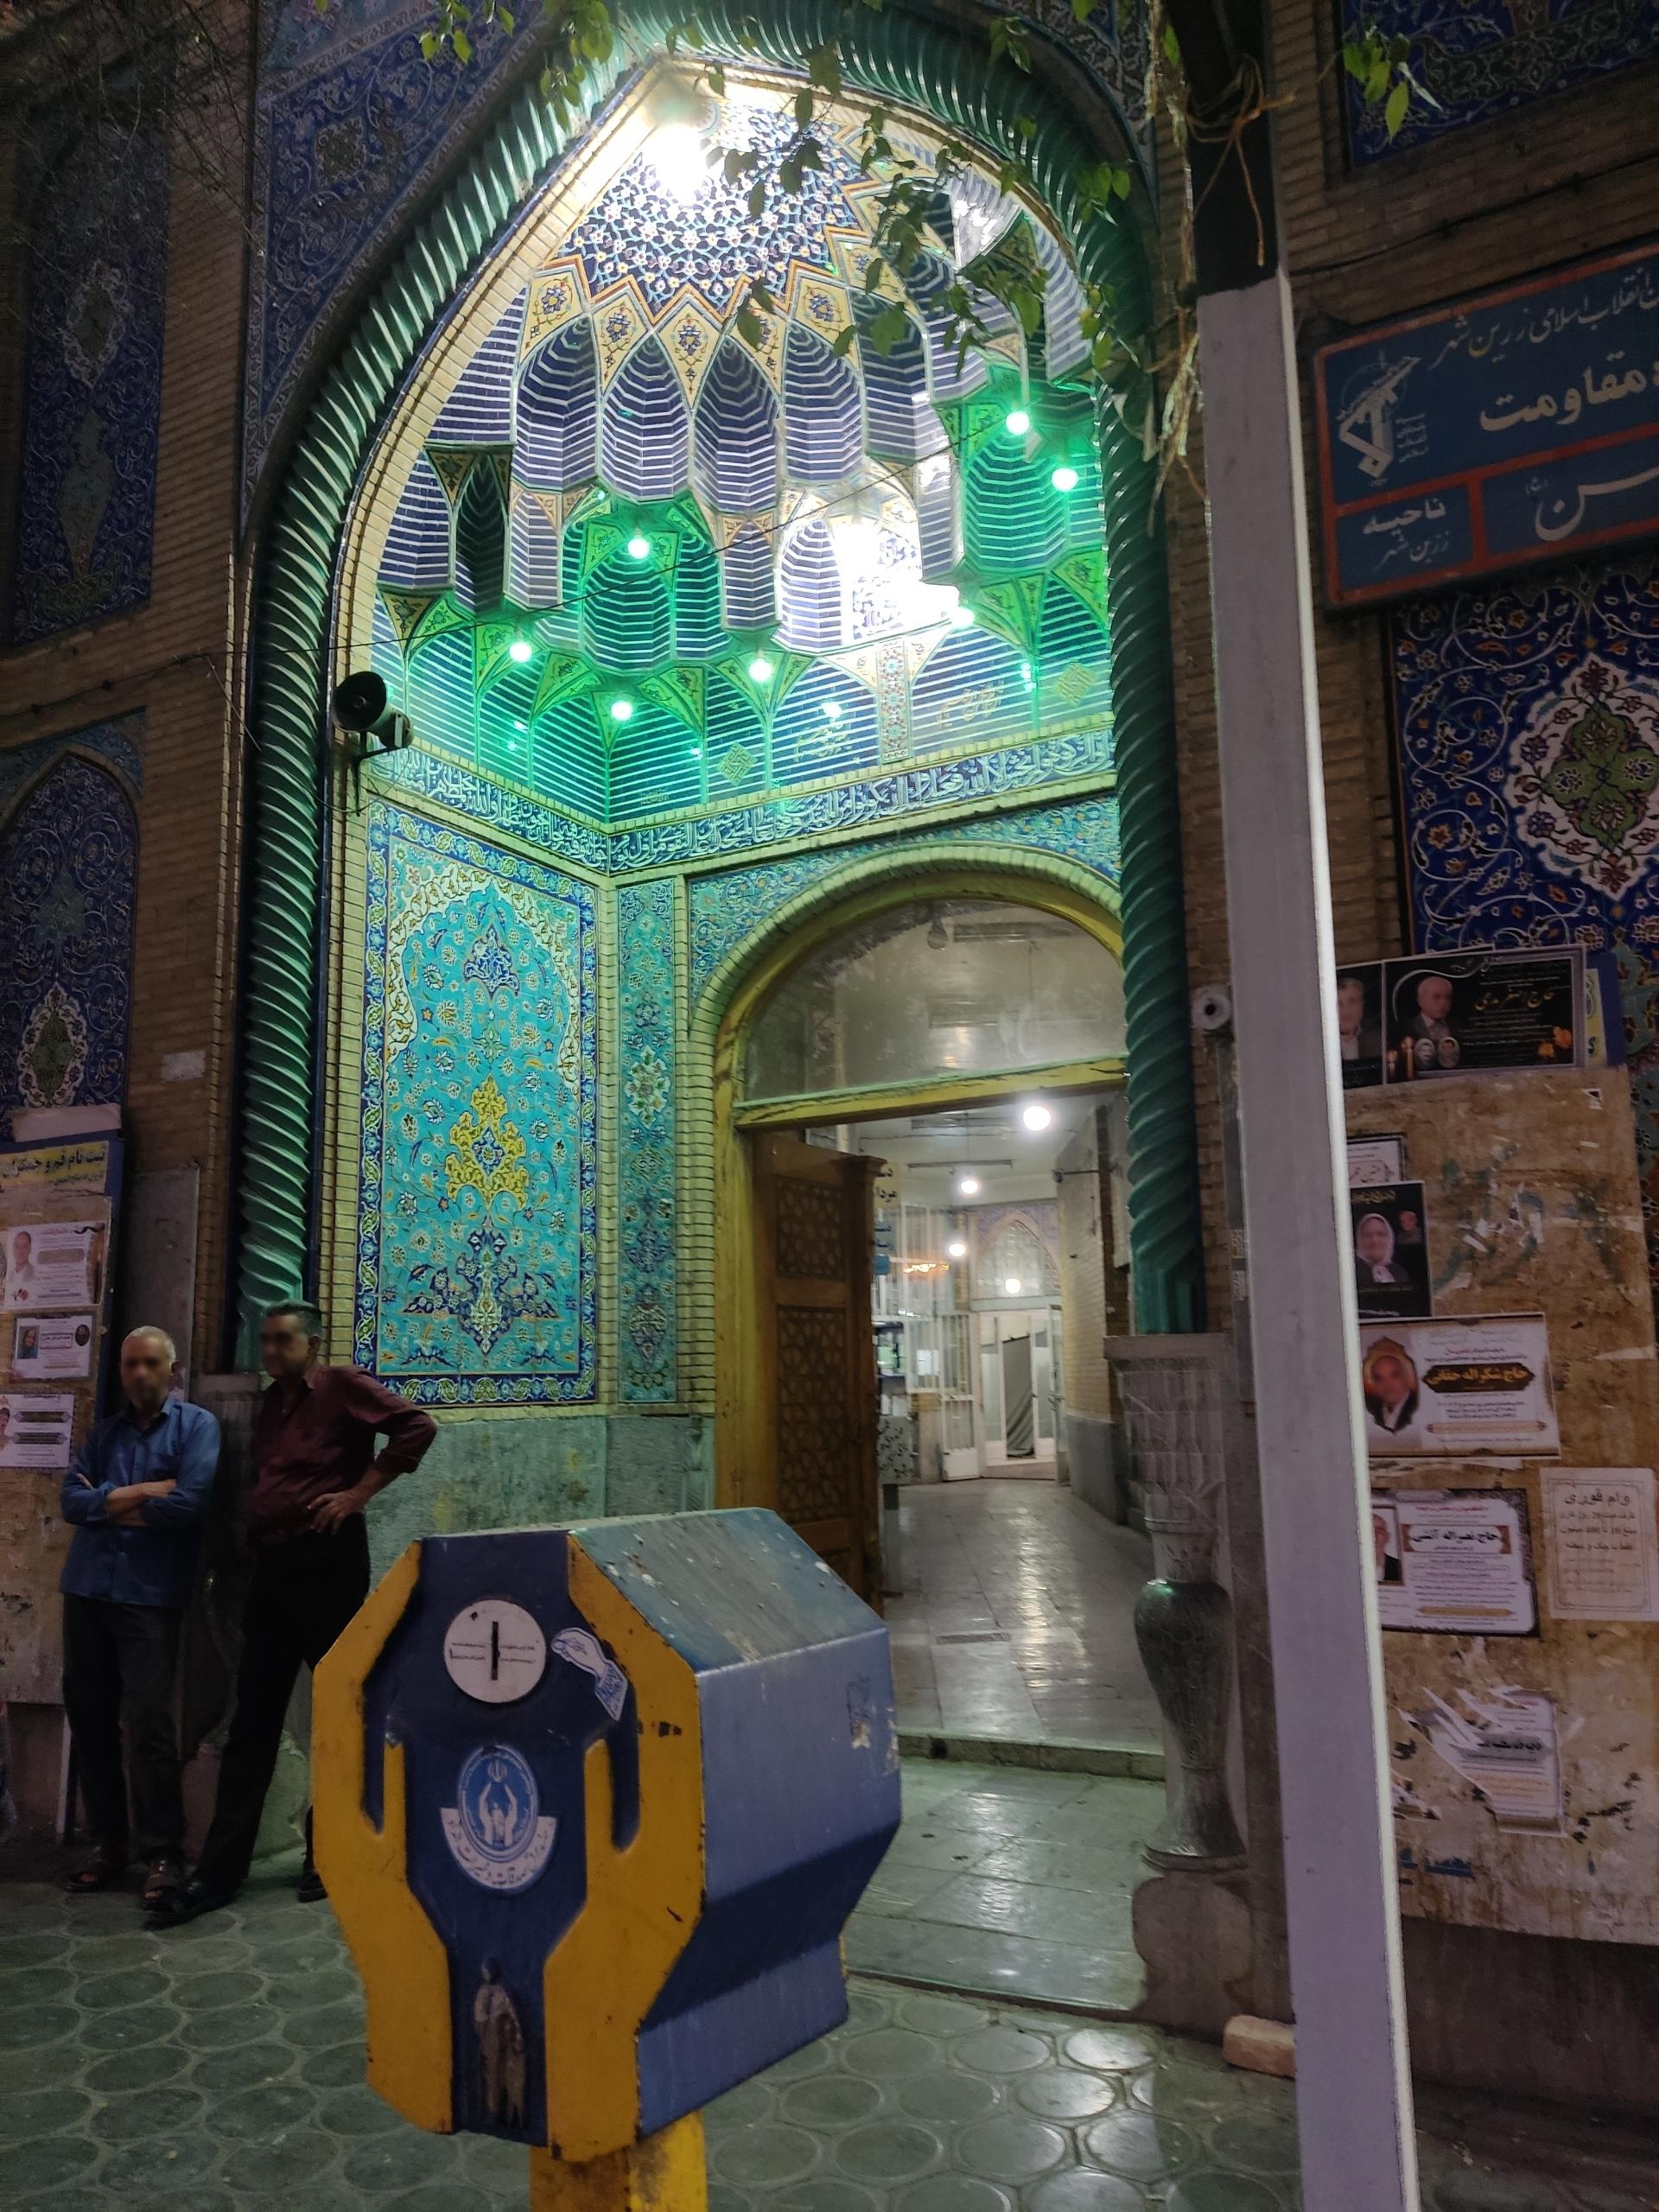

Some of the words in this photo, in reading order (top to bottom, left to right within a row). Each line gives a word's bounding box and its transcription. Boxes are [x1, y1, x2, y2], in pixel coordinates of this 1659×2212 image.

[1479, 350, 1647, 432] مقاومت
[1363, 498, 1446, 535] ناحیه
[68, 1149, 82, 1170] نام
[1564, 1488, 1604, 1506] فوری
[1608, 1491, 1630, 1507] وام
